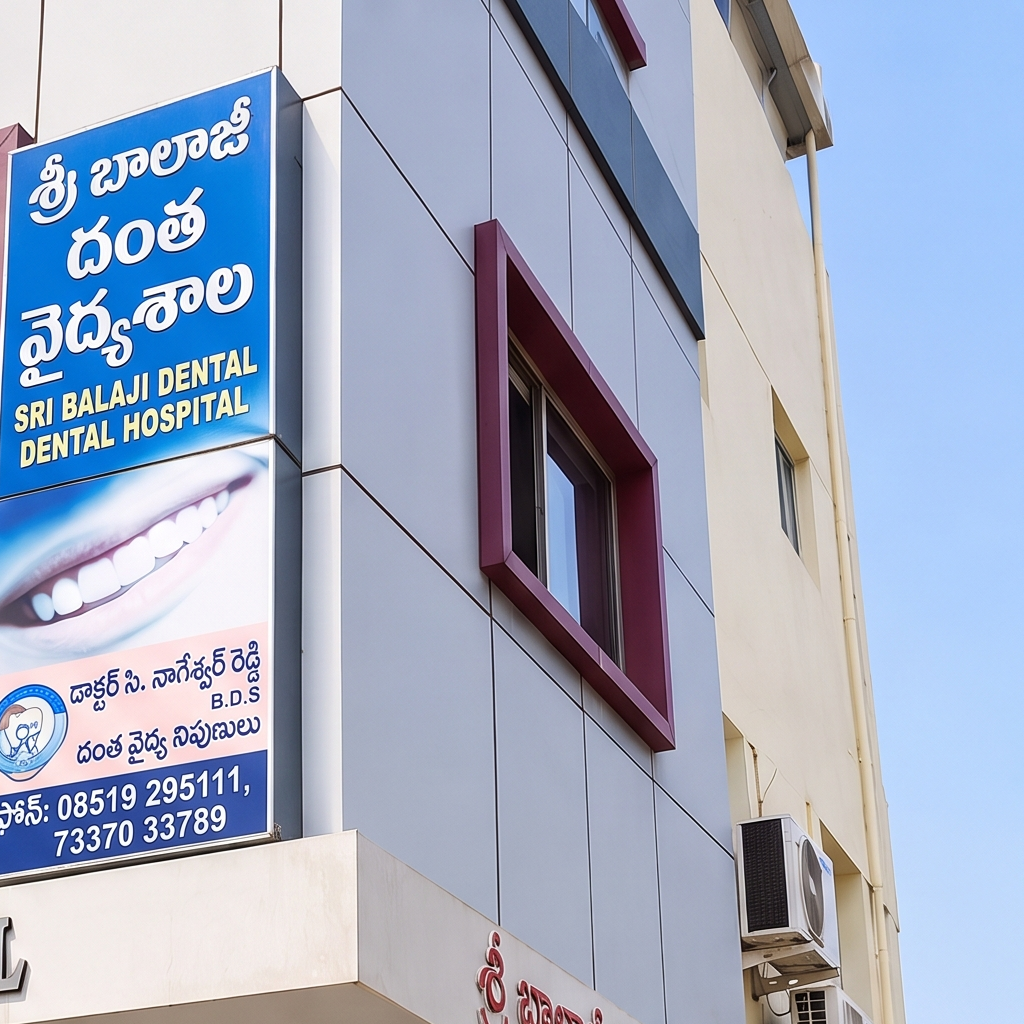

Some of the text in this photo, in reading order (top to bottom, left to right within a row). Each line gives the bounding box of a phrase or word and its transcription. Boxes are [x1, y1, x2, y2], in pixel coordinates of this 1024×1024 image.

[29, 95, 252, 225] శ్రీ బాలాజీ
[66, 186, 207, 280] దంత
[19, 262, 254, 388] వైద్యశాల
[14, 345, 258, 433] SRI BALAJI DENTAL
[20, 386, 250, 469] DENTAL HOSPITAL
[69, 668, 120, 711] డాక్టర్
[211, 686, 261, 710] B.D.S
[76, 716, 261, 764] దంత వైద్య నిపుణులు
[57, 783, 137, 821] 08519
[145, 764, 250, 809] 295111,
[53, 804, 227, 858] 73370 33789
